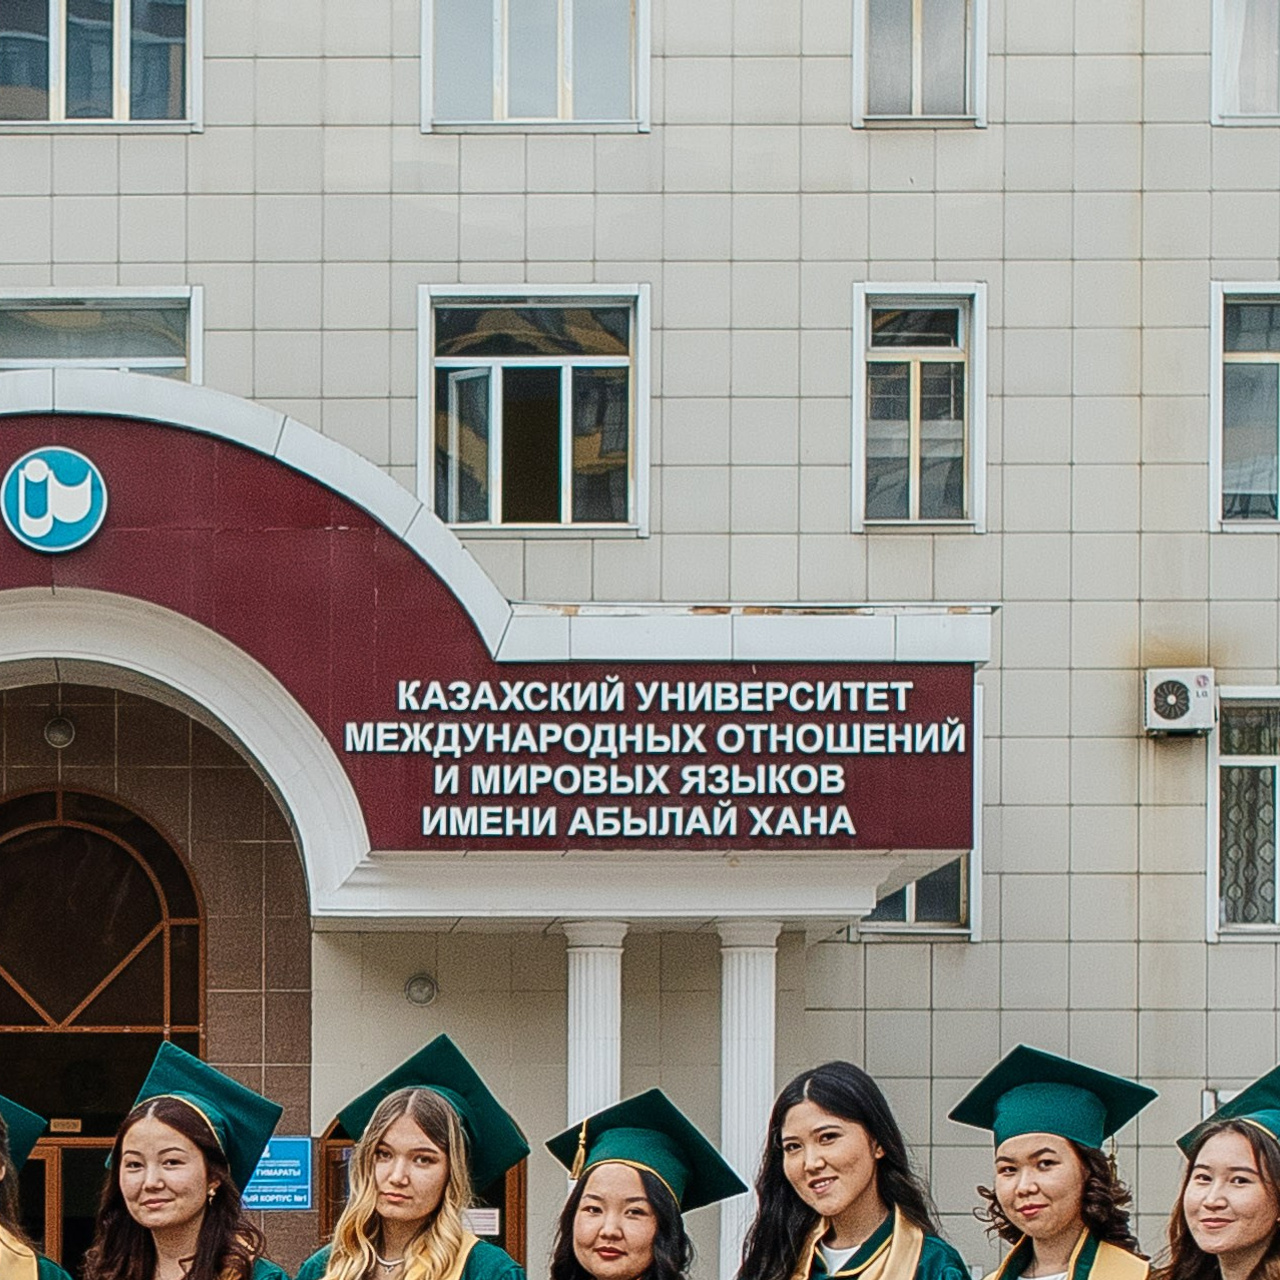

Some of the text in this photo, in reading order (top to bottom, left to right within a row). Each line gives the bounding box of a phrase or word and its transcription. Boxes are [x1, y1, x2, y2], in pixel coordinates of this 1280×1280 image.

[398, 675, 914, 712] КАЗАХСКИЙ УНИВЕРСИТЕТ
[1195, 690, 1209, 698] LG
[345, 717, 966, 759] МЕЖДУНАРОДНЫХ ОТНОШЕНИЙ
[434, 764, 846, 795] И МИРОВЫХ ЯЗЫКОВ
[422, 799, 857, 836] ИМЕНИ АБЫЛАЙ ХАНА
[260, 1194, 293, 1203] КОРПУС
